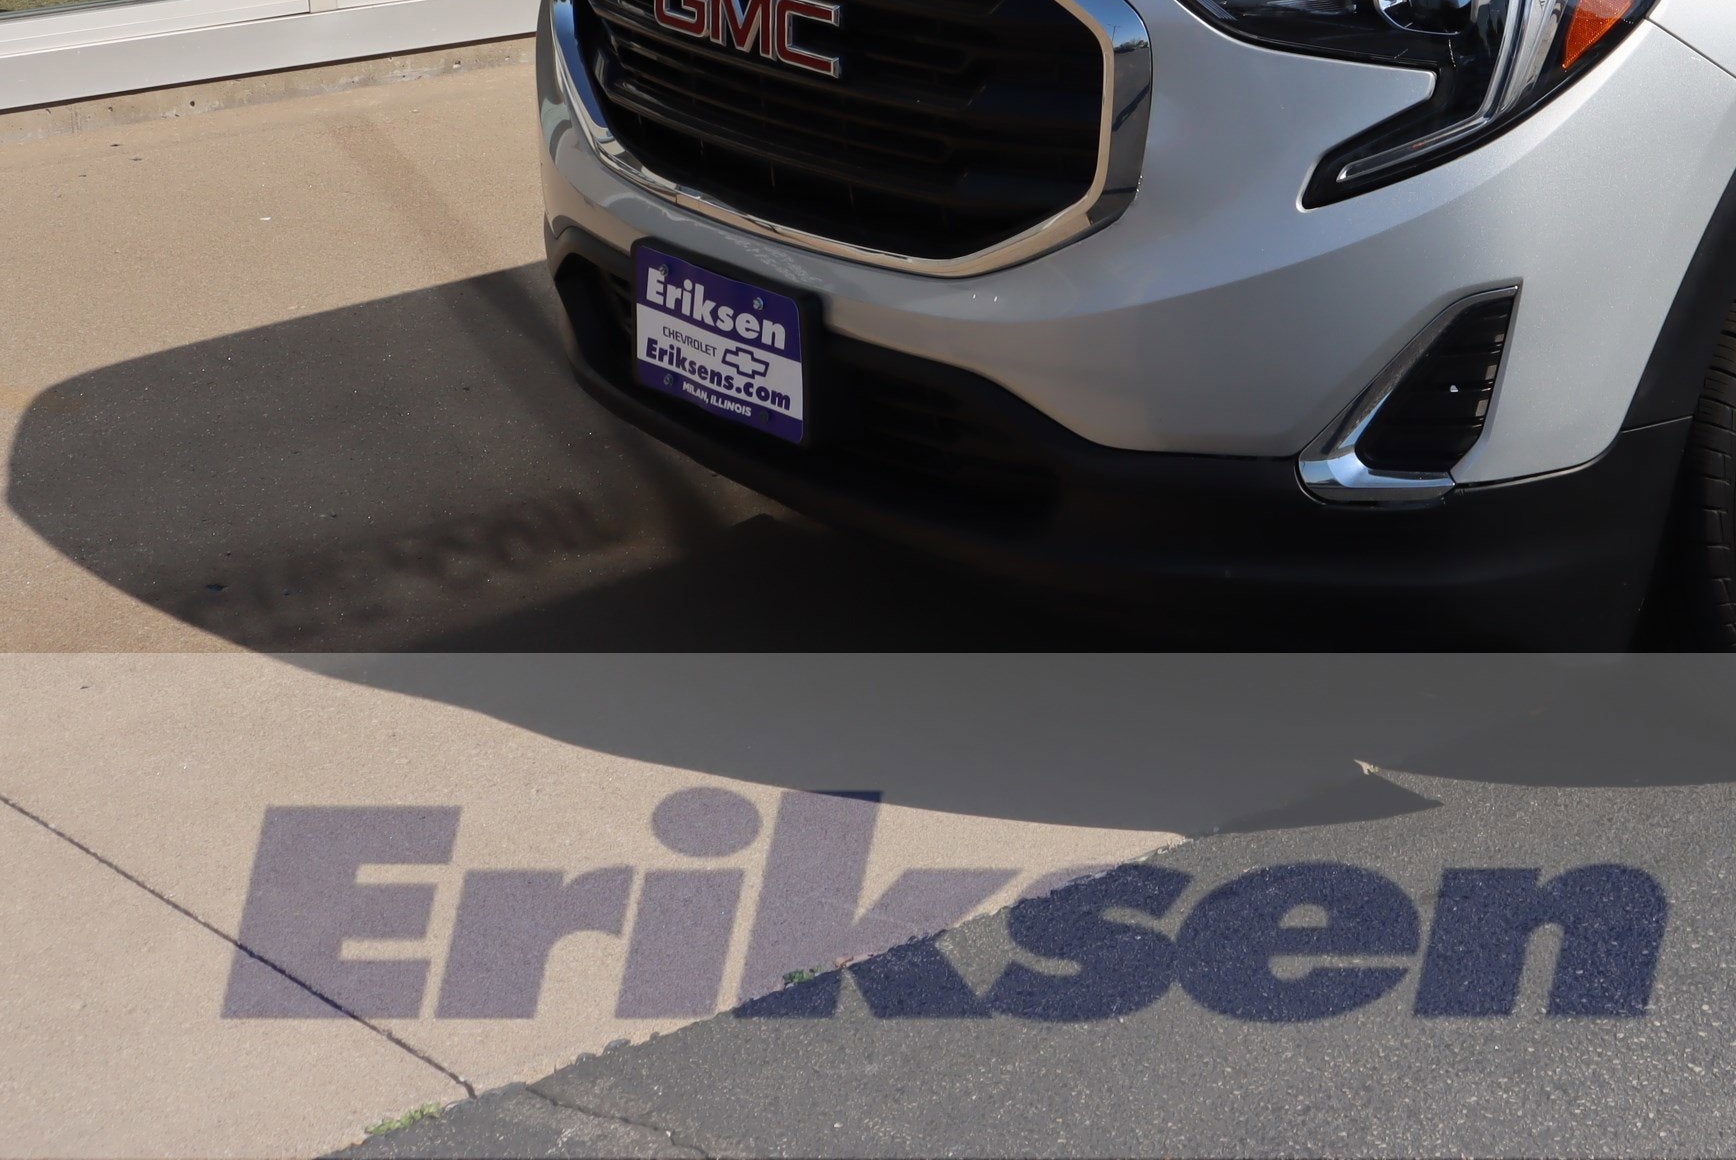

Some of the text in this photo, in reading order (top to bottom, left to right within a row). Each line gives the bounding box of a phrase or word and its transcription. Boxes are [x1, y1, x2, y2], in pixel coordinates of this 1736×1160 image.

[646, 267, 786, 350] Eriksen
[662, 326, 717, 358] CHEVROLET
[646, 337, 791, 411] Eriksens.com
[682, 381, 751, 417] MILAN, ILLINOIS
